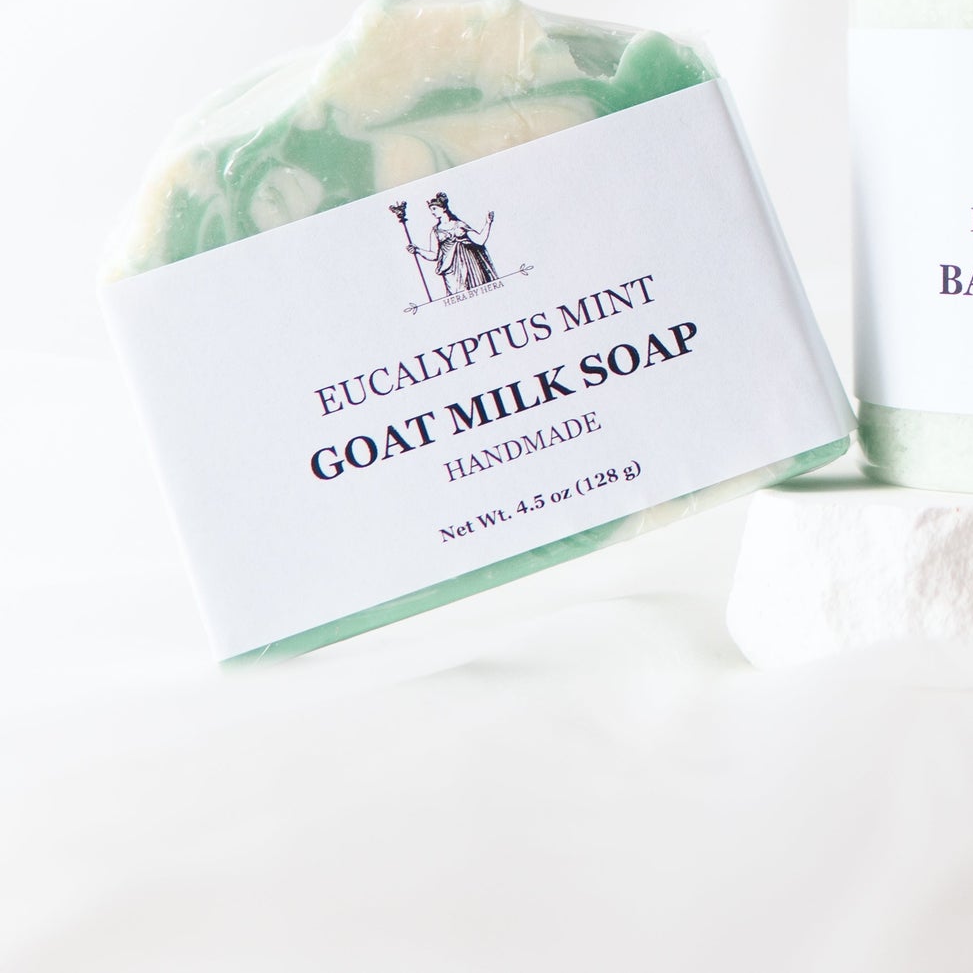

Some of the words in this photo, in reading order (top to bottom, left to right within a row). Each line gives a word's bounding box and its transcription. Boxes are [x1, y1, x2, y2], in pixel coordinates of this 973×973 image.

[443, 293, 467, 307] HERA
[467, 289, 478, 299] BY
[480, 281, 504, 294] HERA
[314, 312, 552, 416] EUCALYPTUS
[556, 275, 654, 332] MINT
[311, 411, 435, 480] GOAT
[444, 365, 576, 435] MILK
[580, 322, 697, 388] SOAP
[444, 412, 601, 482] HANDMADE
[439, 521, 474, 542] Net
[476, 510, 512, 528] Wt.
[517, 494, 545, 514] 4.5
[551, 488, 572, 503] oz
[576, 469, 618, 495] (128
[623, 461, 641, 481] g)
